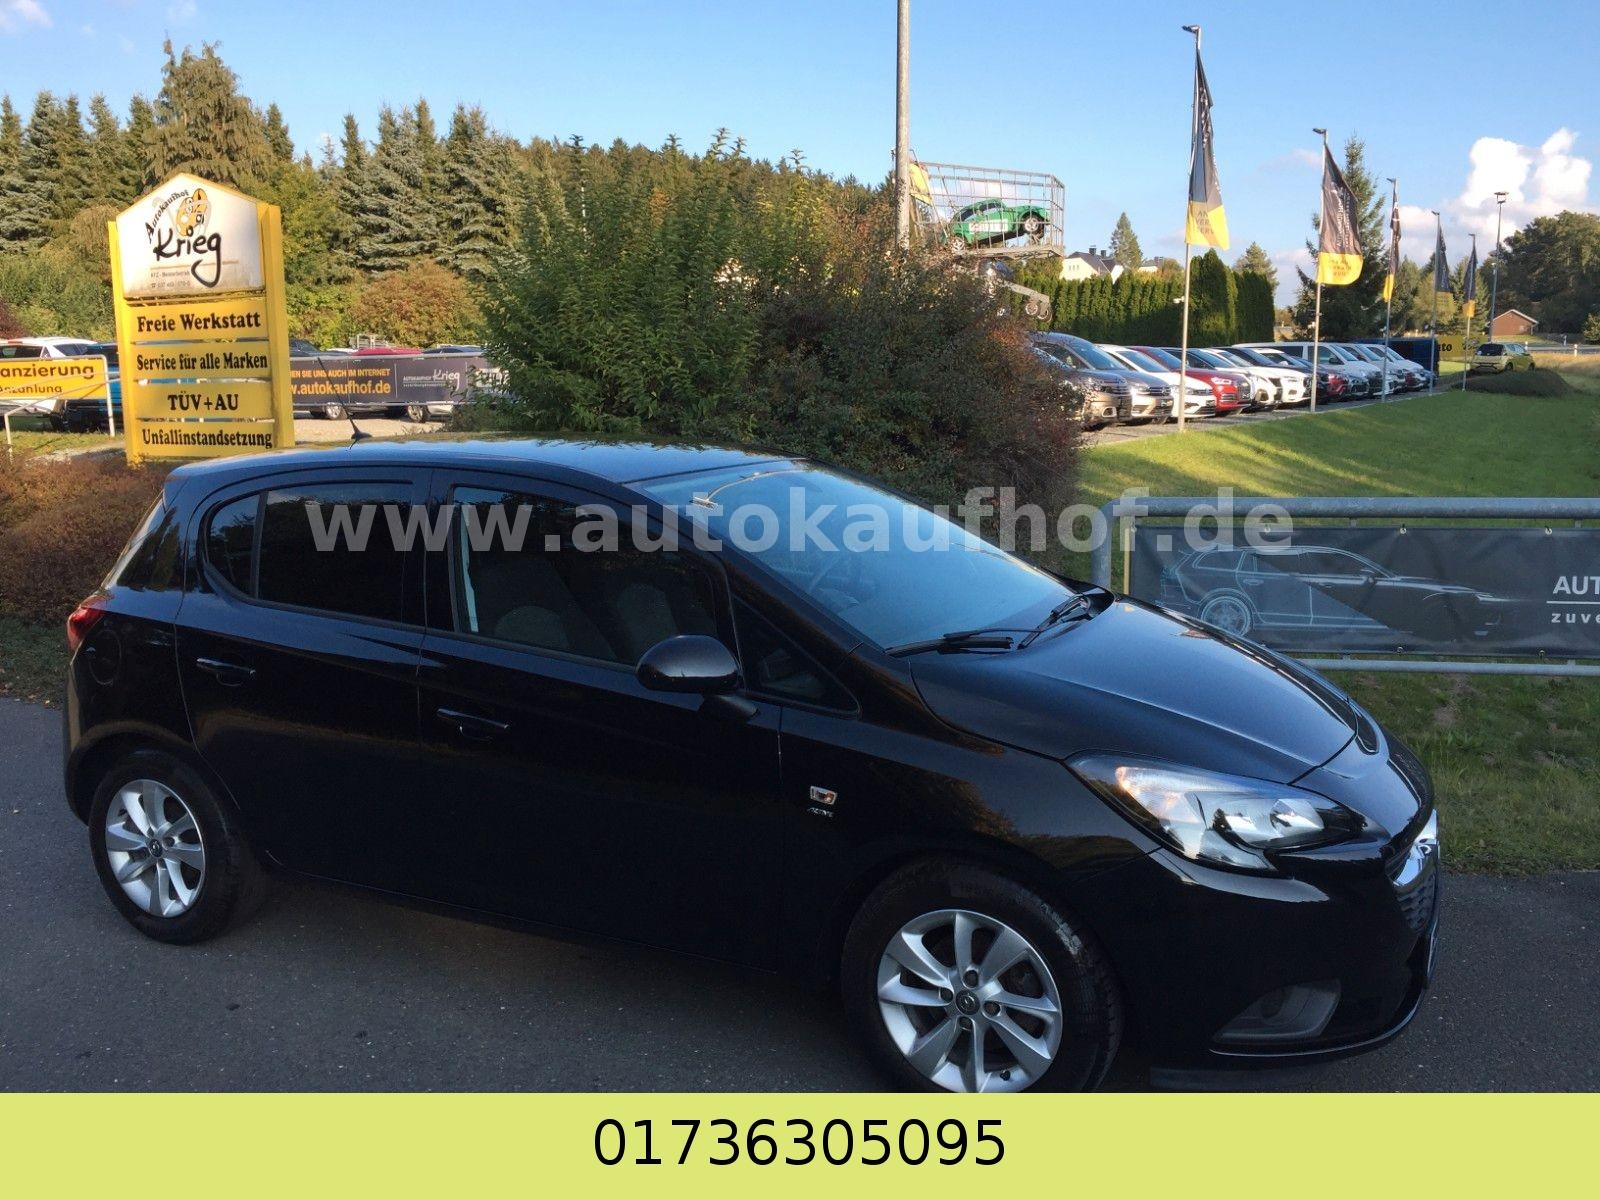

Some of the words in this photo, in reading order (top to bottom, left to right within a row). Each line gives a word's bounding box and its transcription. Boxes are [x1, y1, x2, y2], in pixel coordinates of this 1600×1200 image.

[145, 189, 190, 244] Autokaufhof
[153, 226, 222, 288] Krieg
[137, 315, 176, 333] Freie
[180, 311, 261, 331] Werkstatt
[137, 354, 176, 371] Service
[179, 353, 197, 370] für
[200, 353, 220, 370] alle
[223, 352, 268, 370] Marken
[302, 370, 313, 379] SIE
[313, 369, 327, 379] UNS
[328, 369, 347, 378] AUCH
[348, 368, 357, 378] IM
[358, 367, 391, 377] INTERNET
[142, 429, 273, 449] Unfallinstandsetzung
[1552, 575, 1600, 595] AUT
